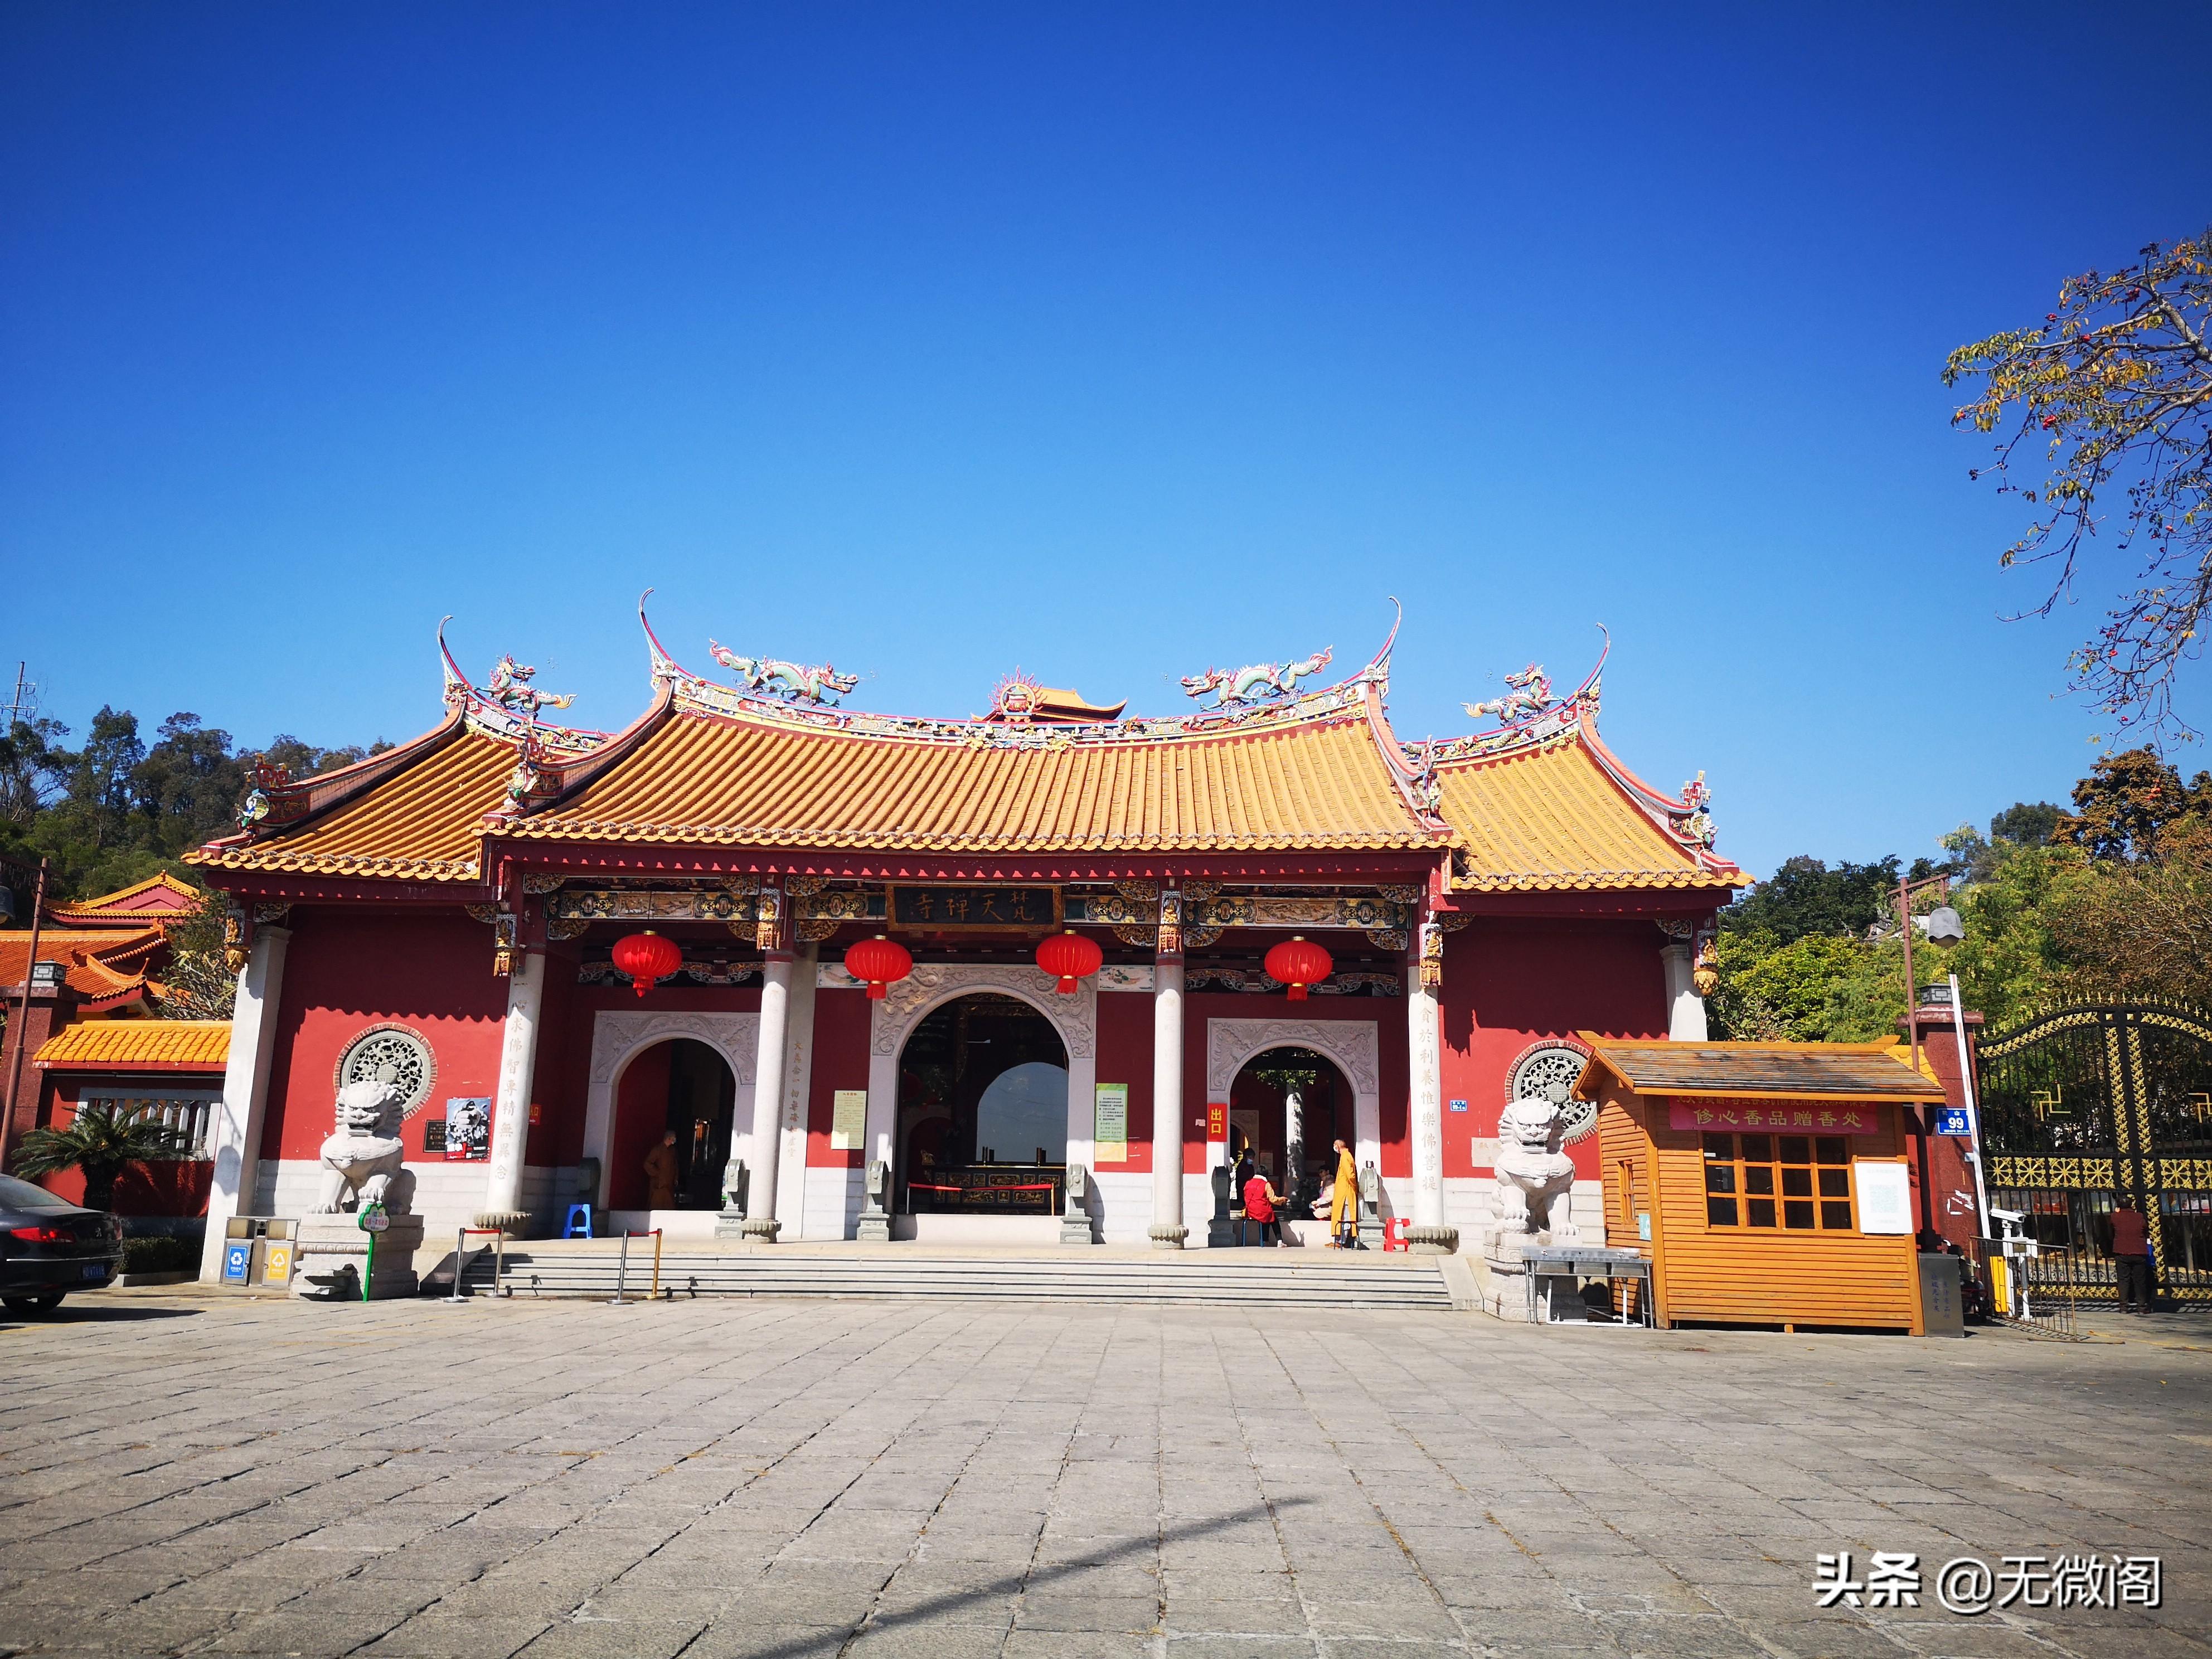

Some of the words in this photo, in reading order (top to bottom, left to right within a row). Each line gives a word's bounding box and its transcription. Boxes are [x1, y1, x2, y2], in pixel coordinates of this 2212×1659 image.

[1211, 1108, 1222, 1134] 出口
[1693, 1108, 1862, 1128] 修心香品赠香处
[1948, 1117, 1964, 1129] 99
